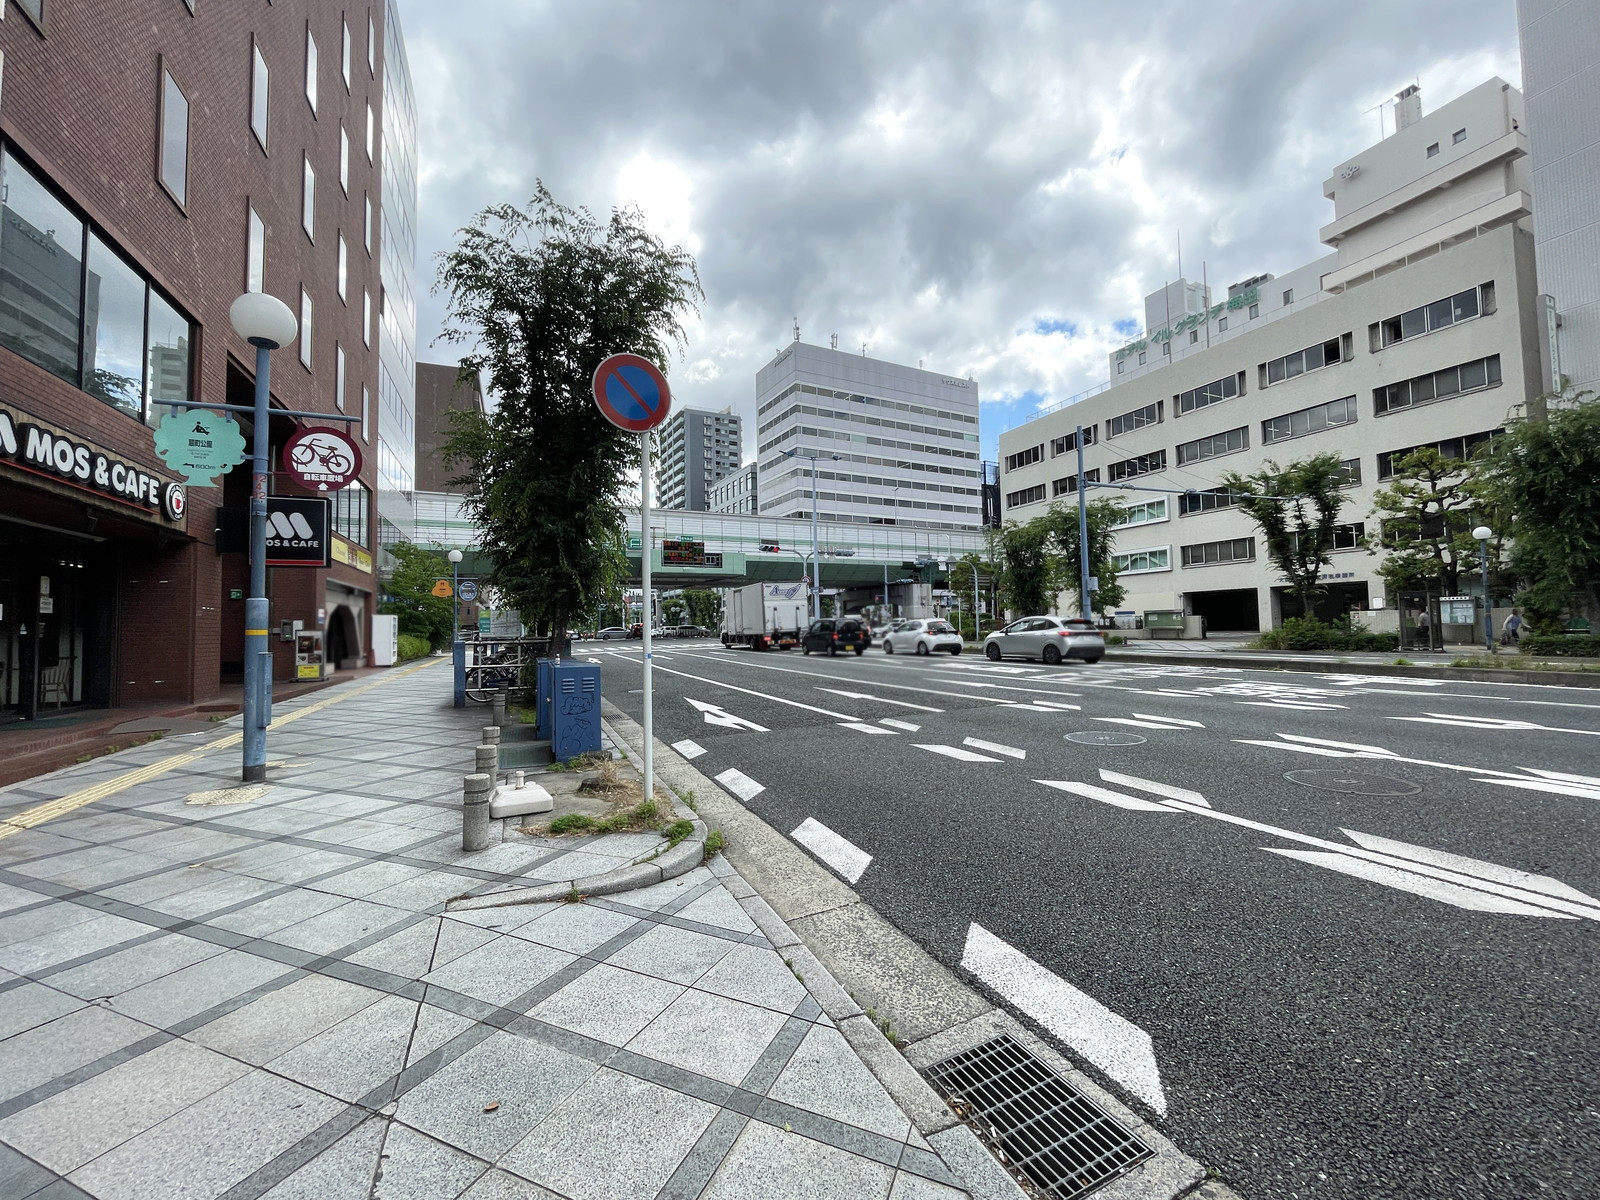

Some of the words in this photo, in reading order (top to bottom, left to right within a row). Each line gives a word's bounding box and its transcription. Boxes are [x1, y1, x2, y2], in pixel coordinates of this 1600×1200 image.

[26, 427, 91, 479] MOS
[95, 456, 110, 486] &
[112, 463, 161, 505] CAFE
[303, 473, 344, 482] 自転車置場
